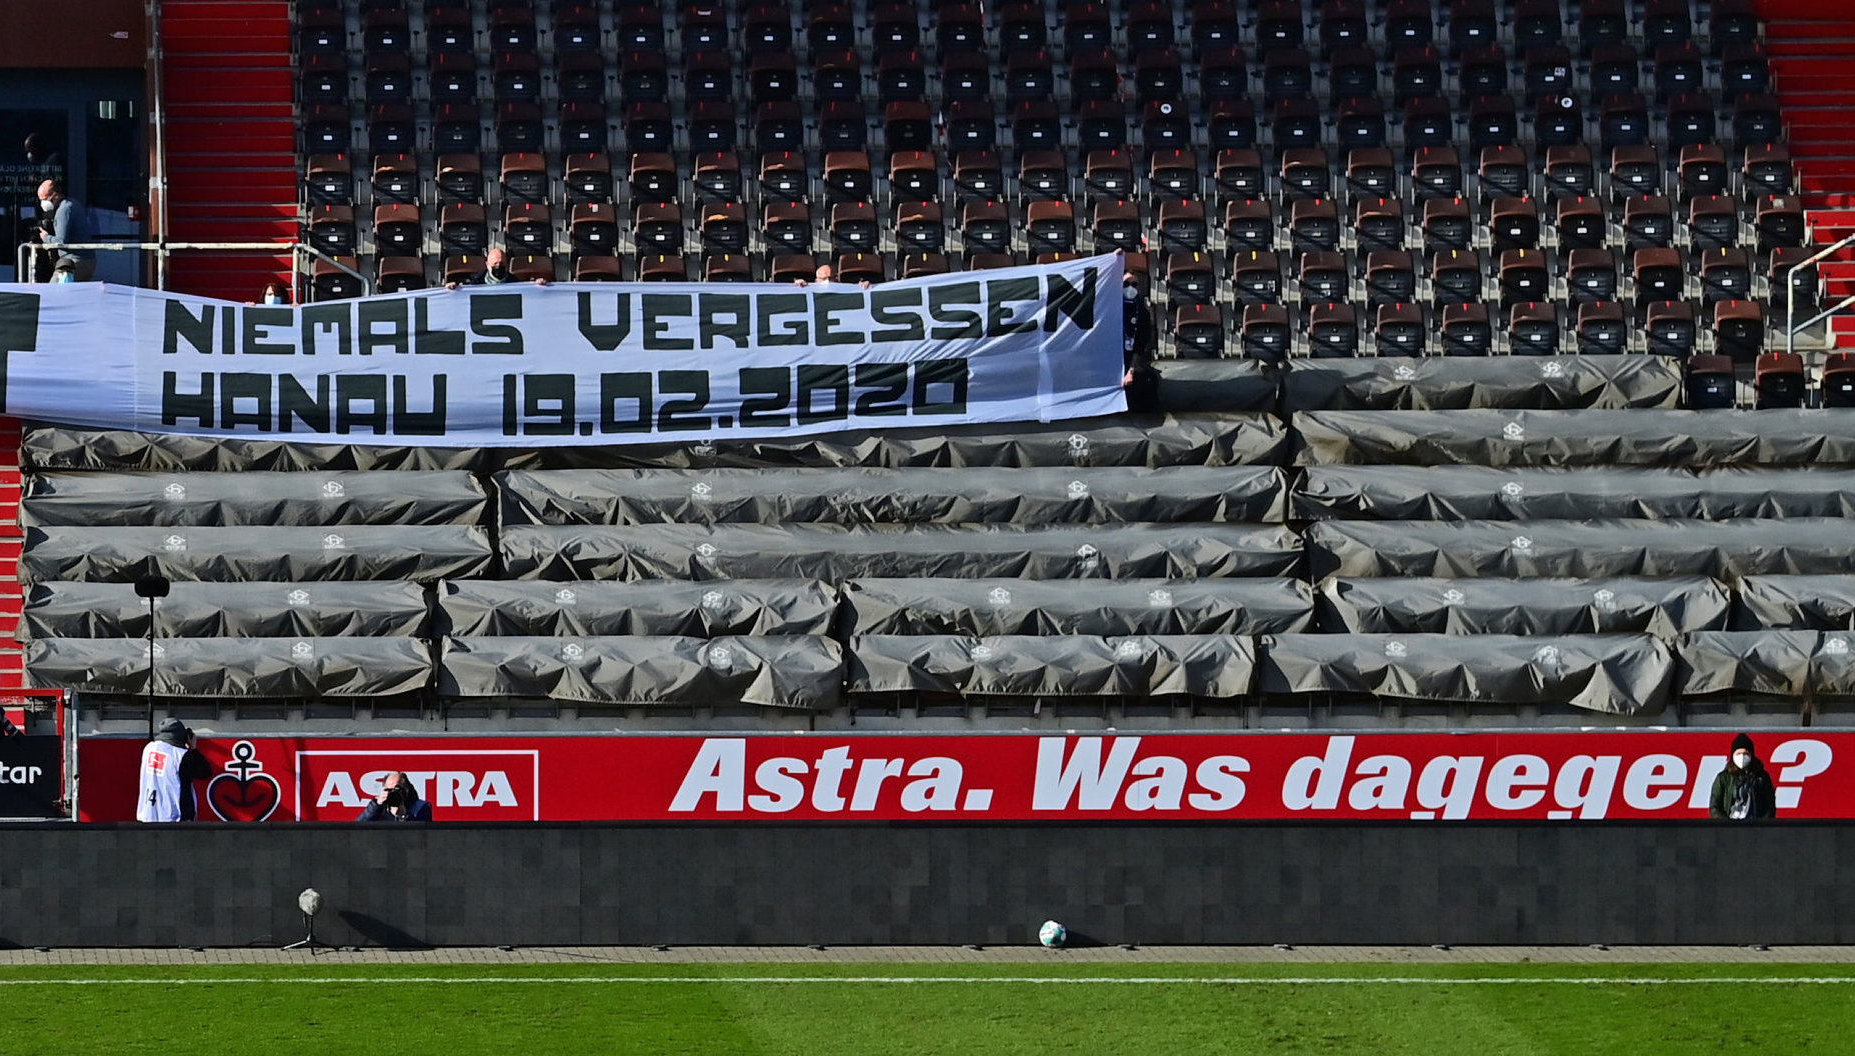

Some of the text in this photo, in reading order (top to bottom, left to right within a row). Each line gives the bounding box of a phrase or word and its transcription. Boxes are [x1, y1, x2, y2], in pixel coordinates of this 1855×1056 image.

[163, 267, 1097, 355] NIEMALS VERGESSEN
[162, 357, 968, 436] HANAU 19.02.2020
[668, 738, 994, 813] Astra.
[1033, 737, 1250, 812] Was
